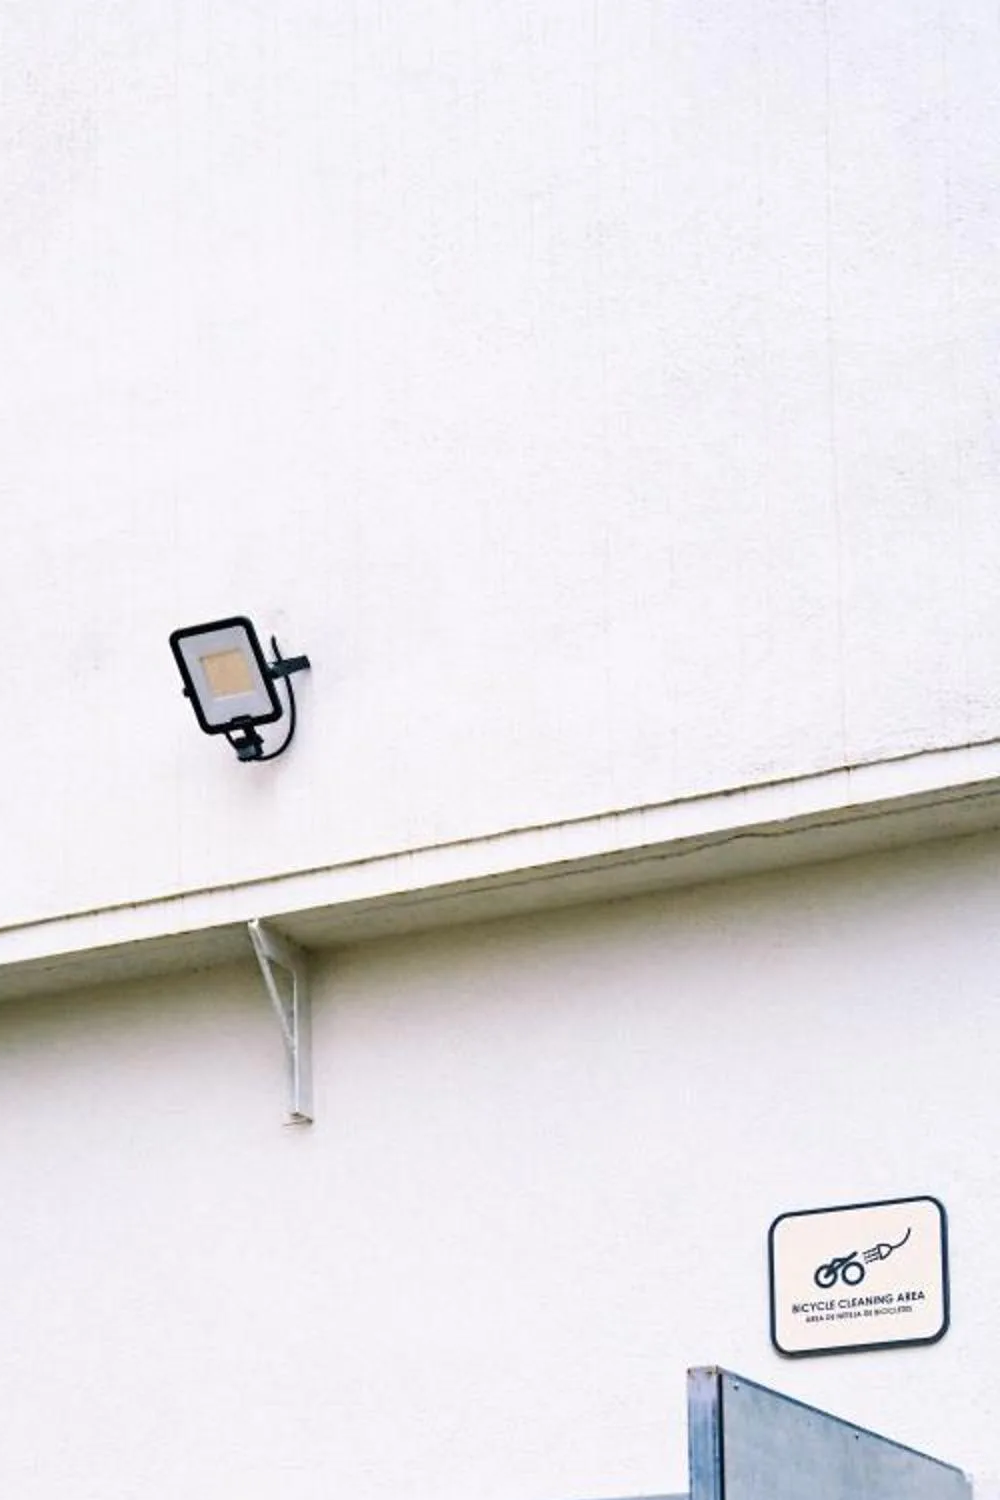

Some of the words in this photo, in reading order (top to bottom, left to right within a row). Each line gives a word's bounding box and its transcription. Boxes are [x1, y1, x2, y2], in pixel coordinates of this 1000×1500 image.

[792, 1301, 834, 1314] BICYCLE
[838, 1294, 893, 1308] CLEANING
[898, 1290, 925, 1302] AREA
